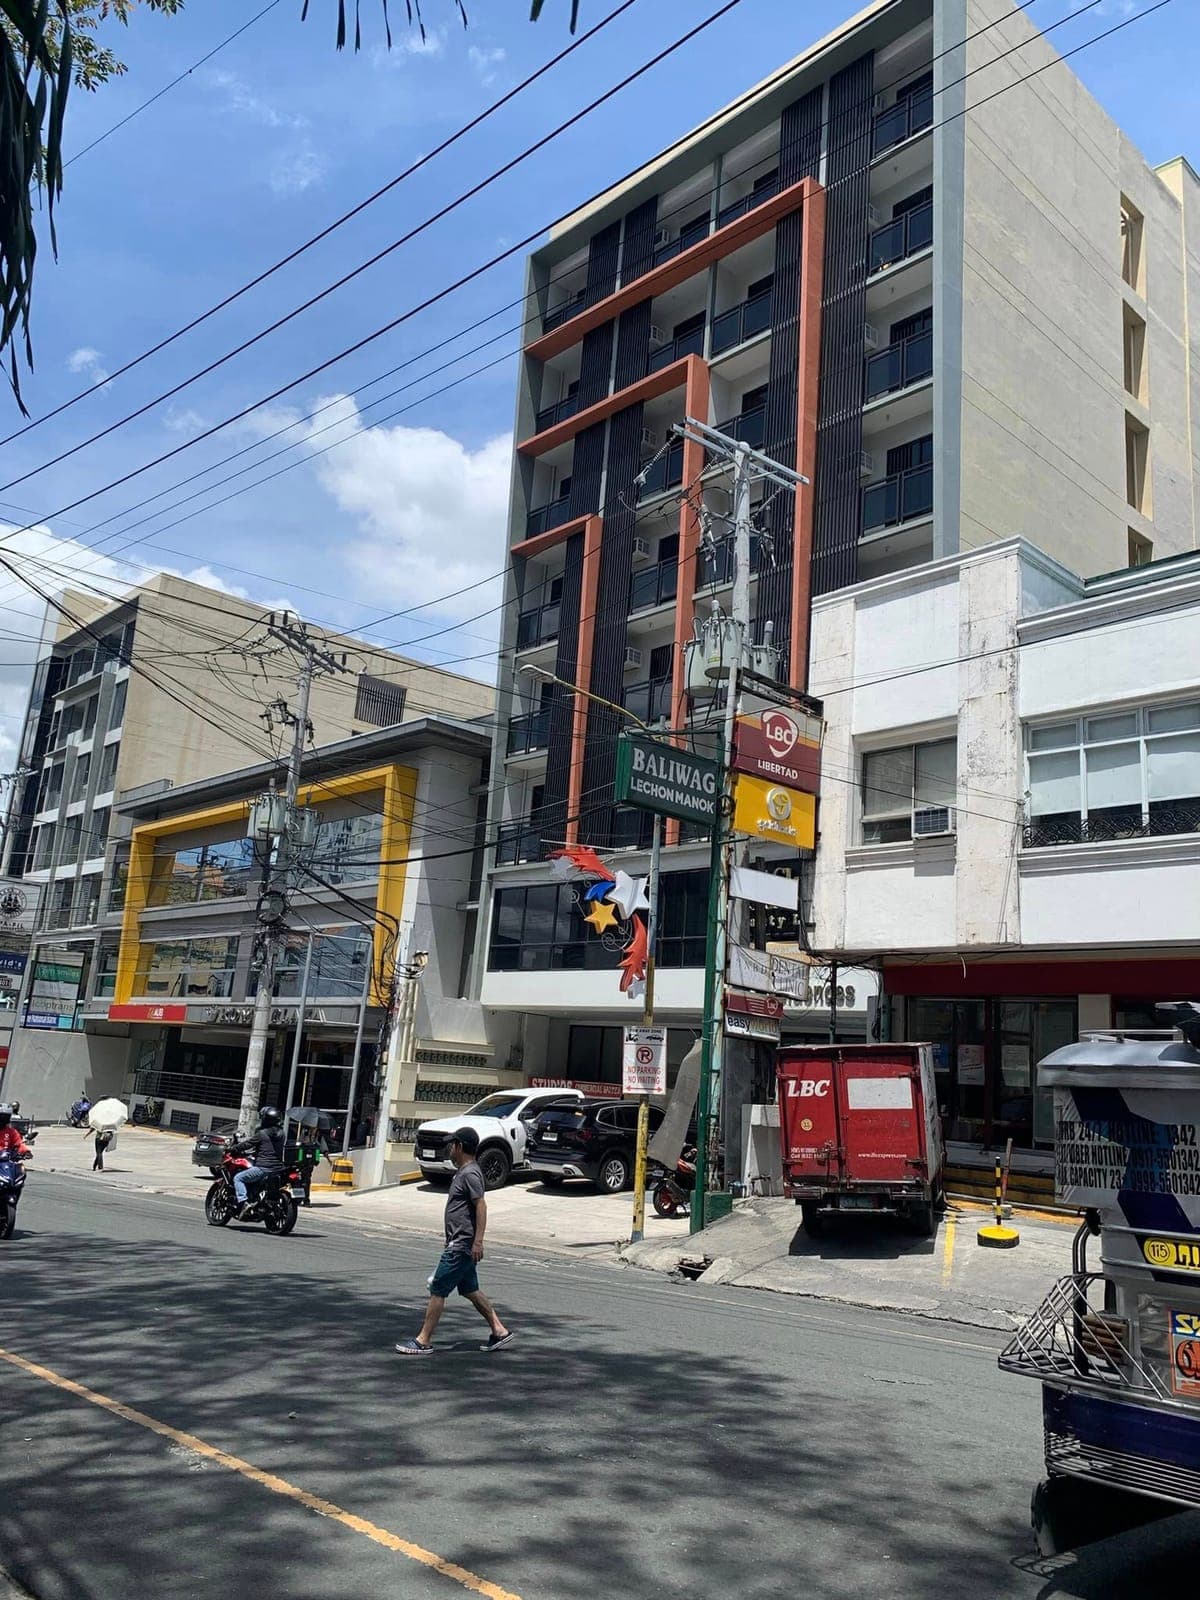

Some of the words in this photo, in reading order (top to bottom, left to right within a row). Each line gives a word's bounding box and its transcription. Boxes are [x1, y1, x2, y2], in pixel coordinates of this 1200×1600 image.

[765, 723, 795, 746] LBC
[632, 747, 716, 795] BALIWAG
[757, 759, 799, 780] LIBERTAD
[630, 776, 674, 804] LECHON
[674, 790, 715, 815] MANOK
[637, 1067, 662, 1075] PARKING
[787, 1079, 831, 1098] LBC
[1070, 1166, 1107, 1189] CAPACITY
[1150, 1243, 1168, 1258] 115
[1174, 1243, 1200, 1267] LI
